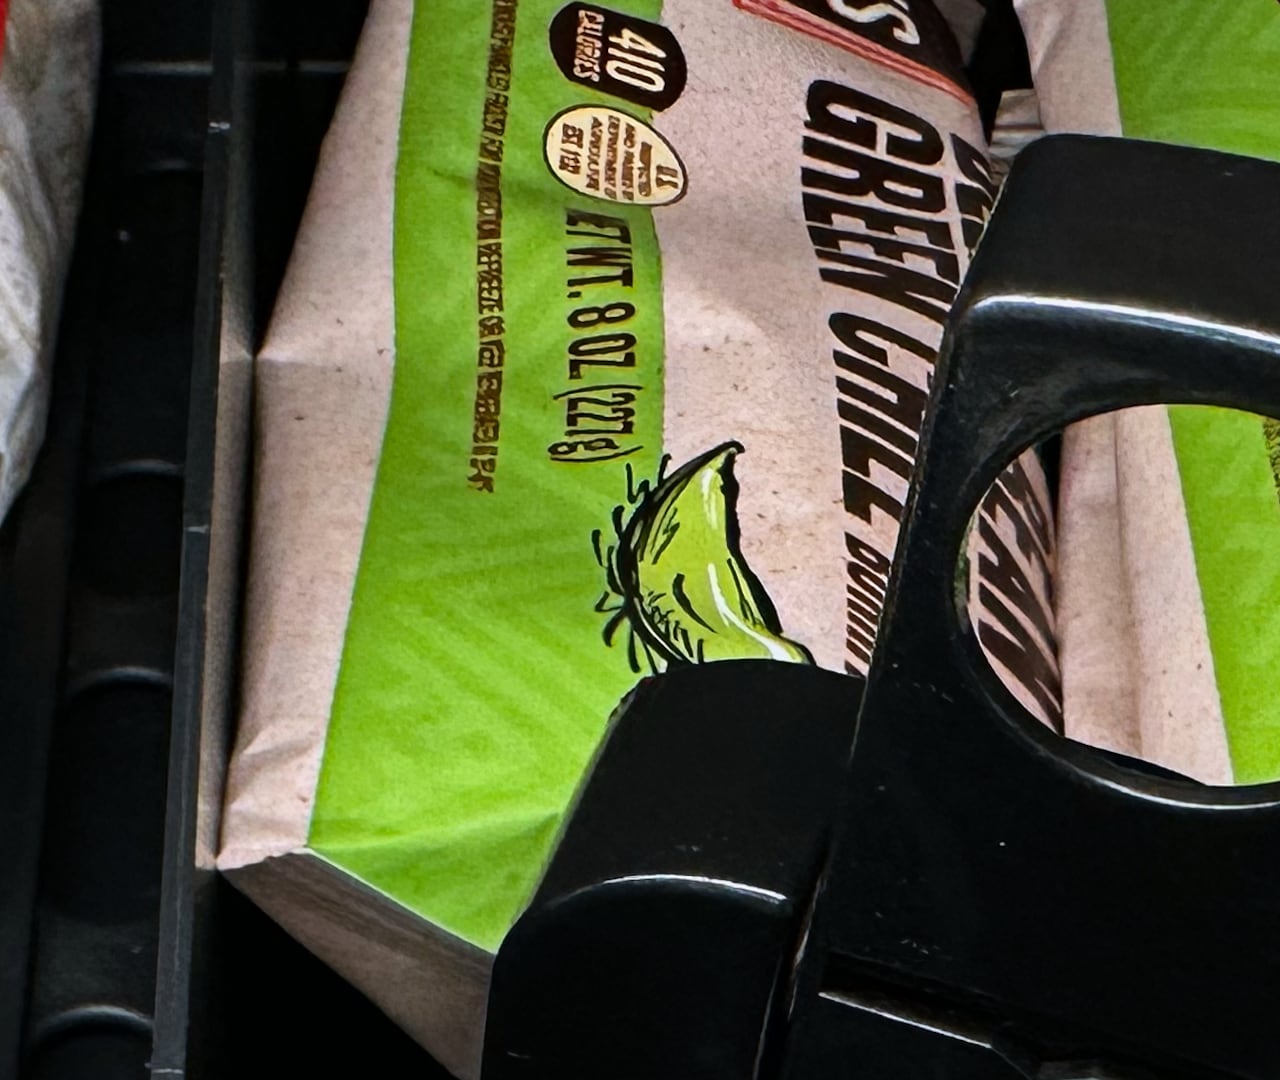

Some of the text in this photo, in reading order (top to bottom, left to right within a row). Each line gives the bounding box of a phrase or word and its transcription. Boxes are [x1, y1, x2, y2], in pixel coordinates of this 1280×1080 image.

[606, 28, 667, 92] 410
[801, 79, 961, 325] GREEN
[567, 302, 636, 328] 8
[568, 333, 637, 380] OZ
